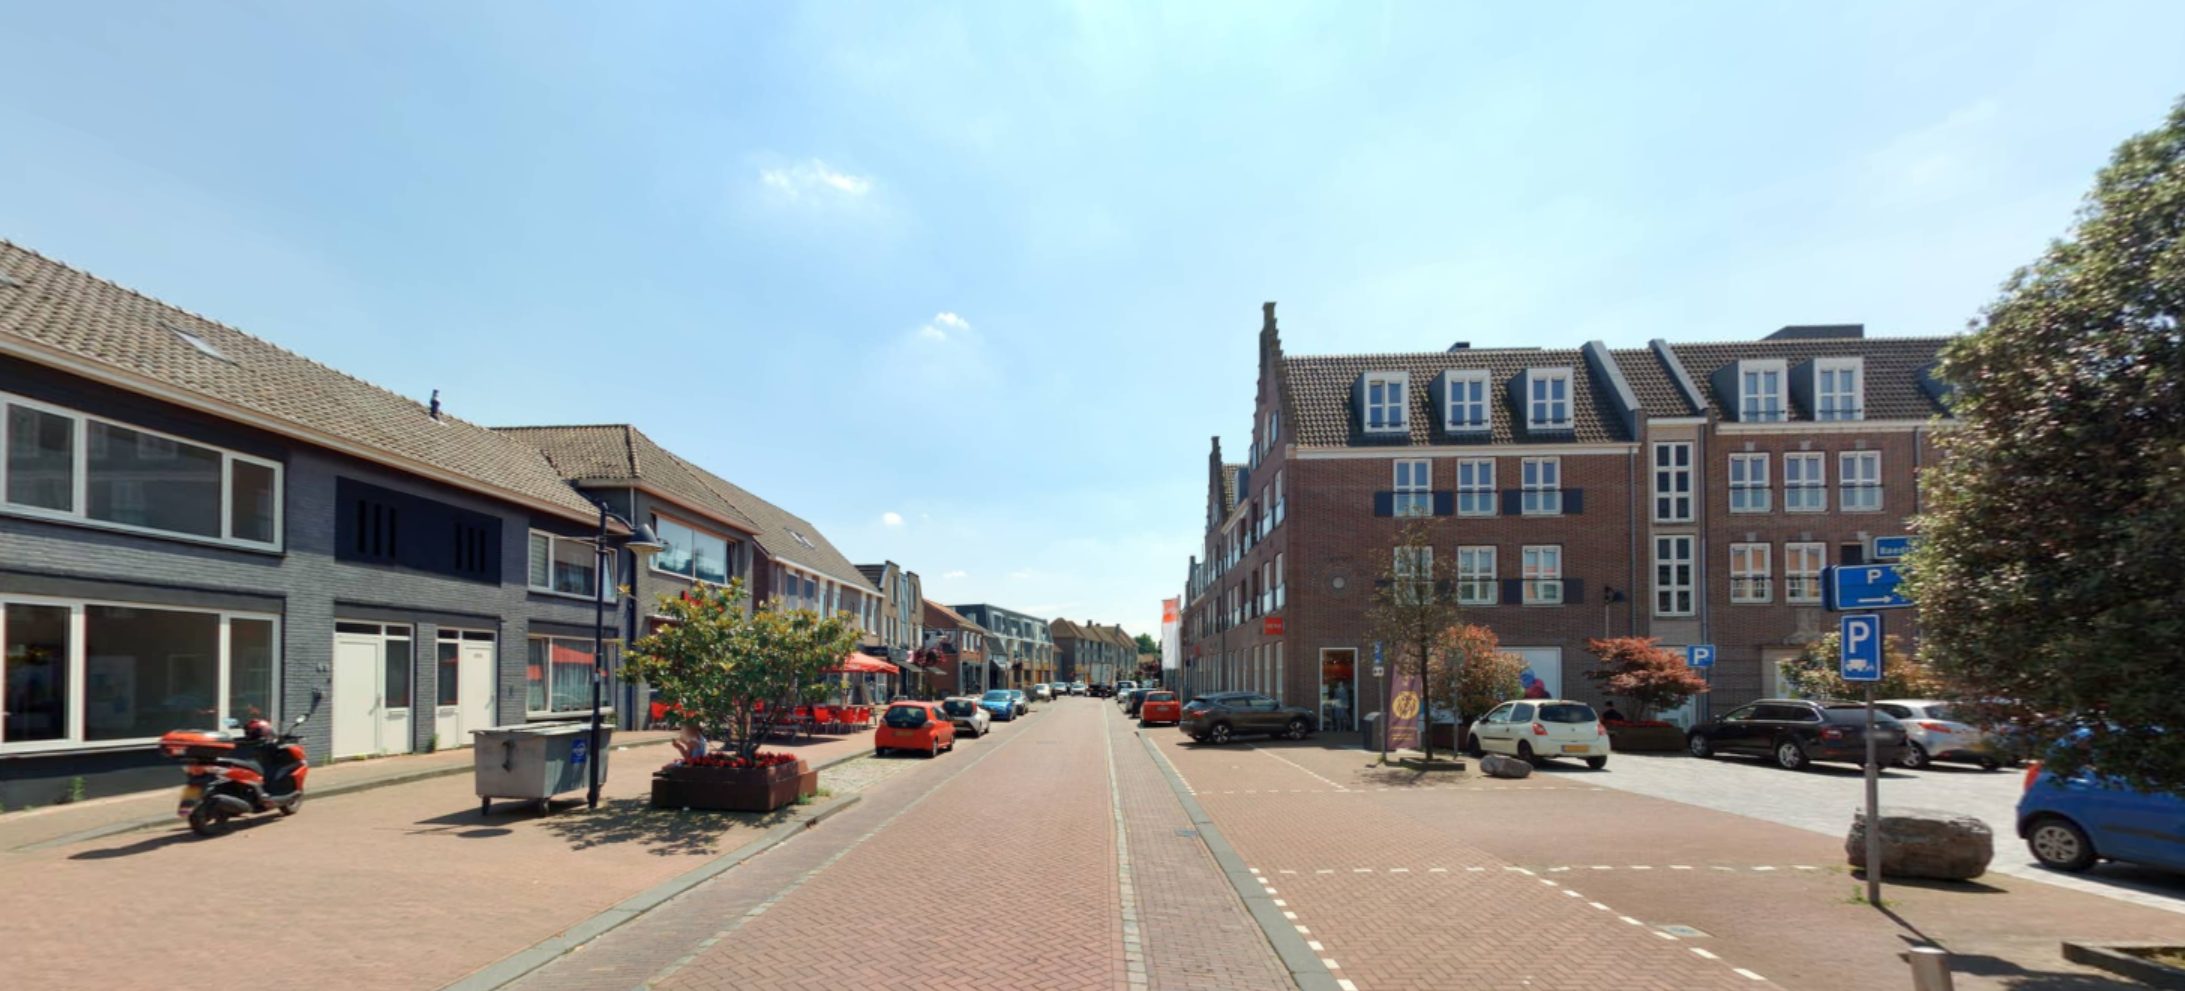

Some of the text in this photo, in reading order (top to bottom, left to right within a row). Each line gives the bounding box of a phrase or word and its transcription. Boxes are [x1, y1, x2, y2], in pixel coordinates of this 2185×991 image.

[1867, 569, 1882, 584] P
[1848, 621, 1870, 654] P
[1693, 648, 1709, 665] P
